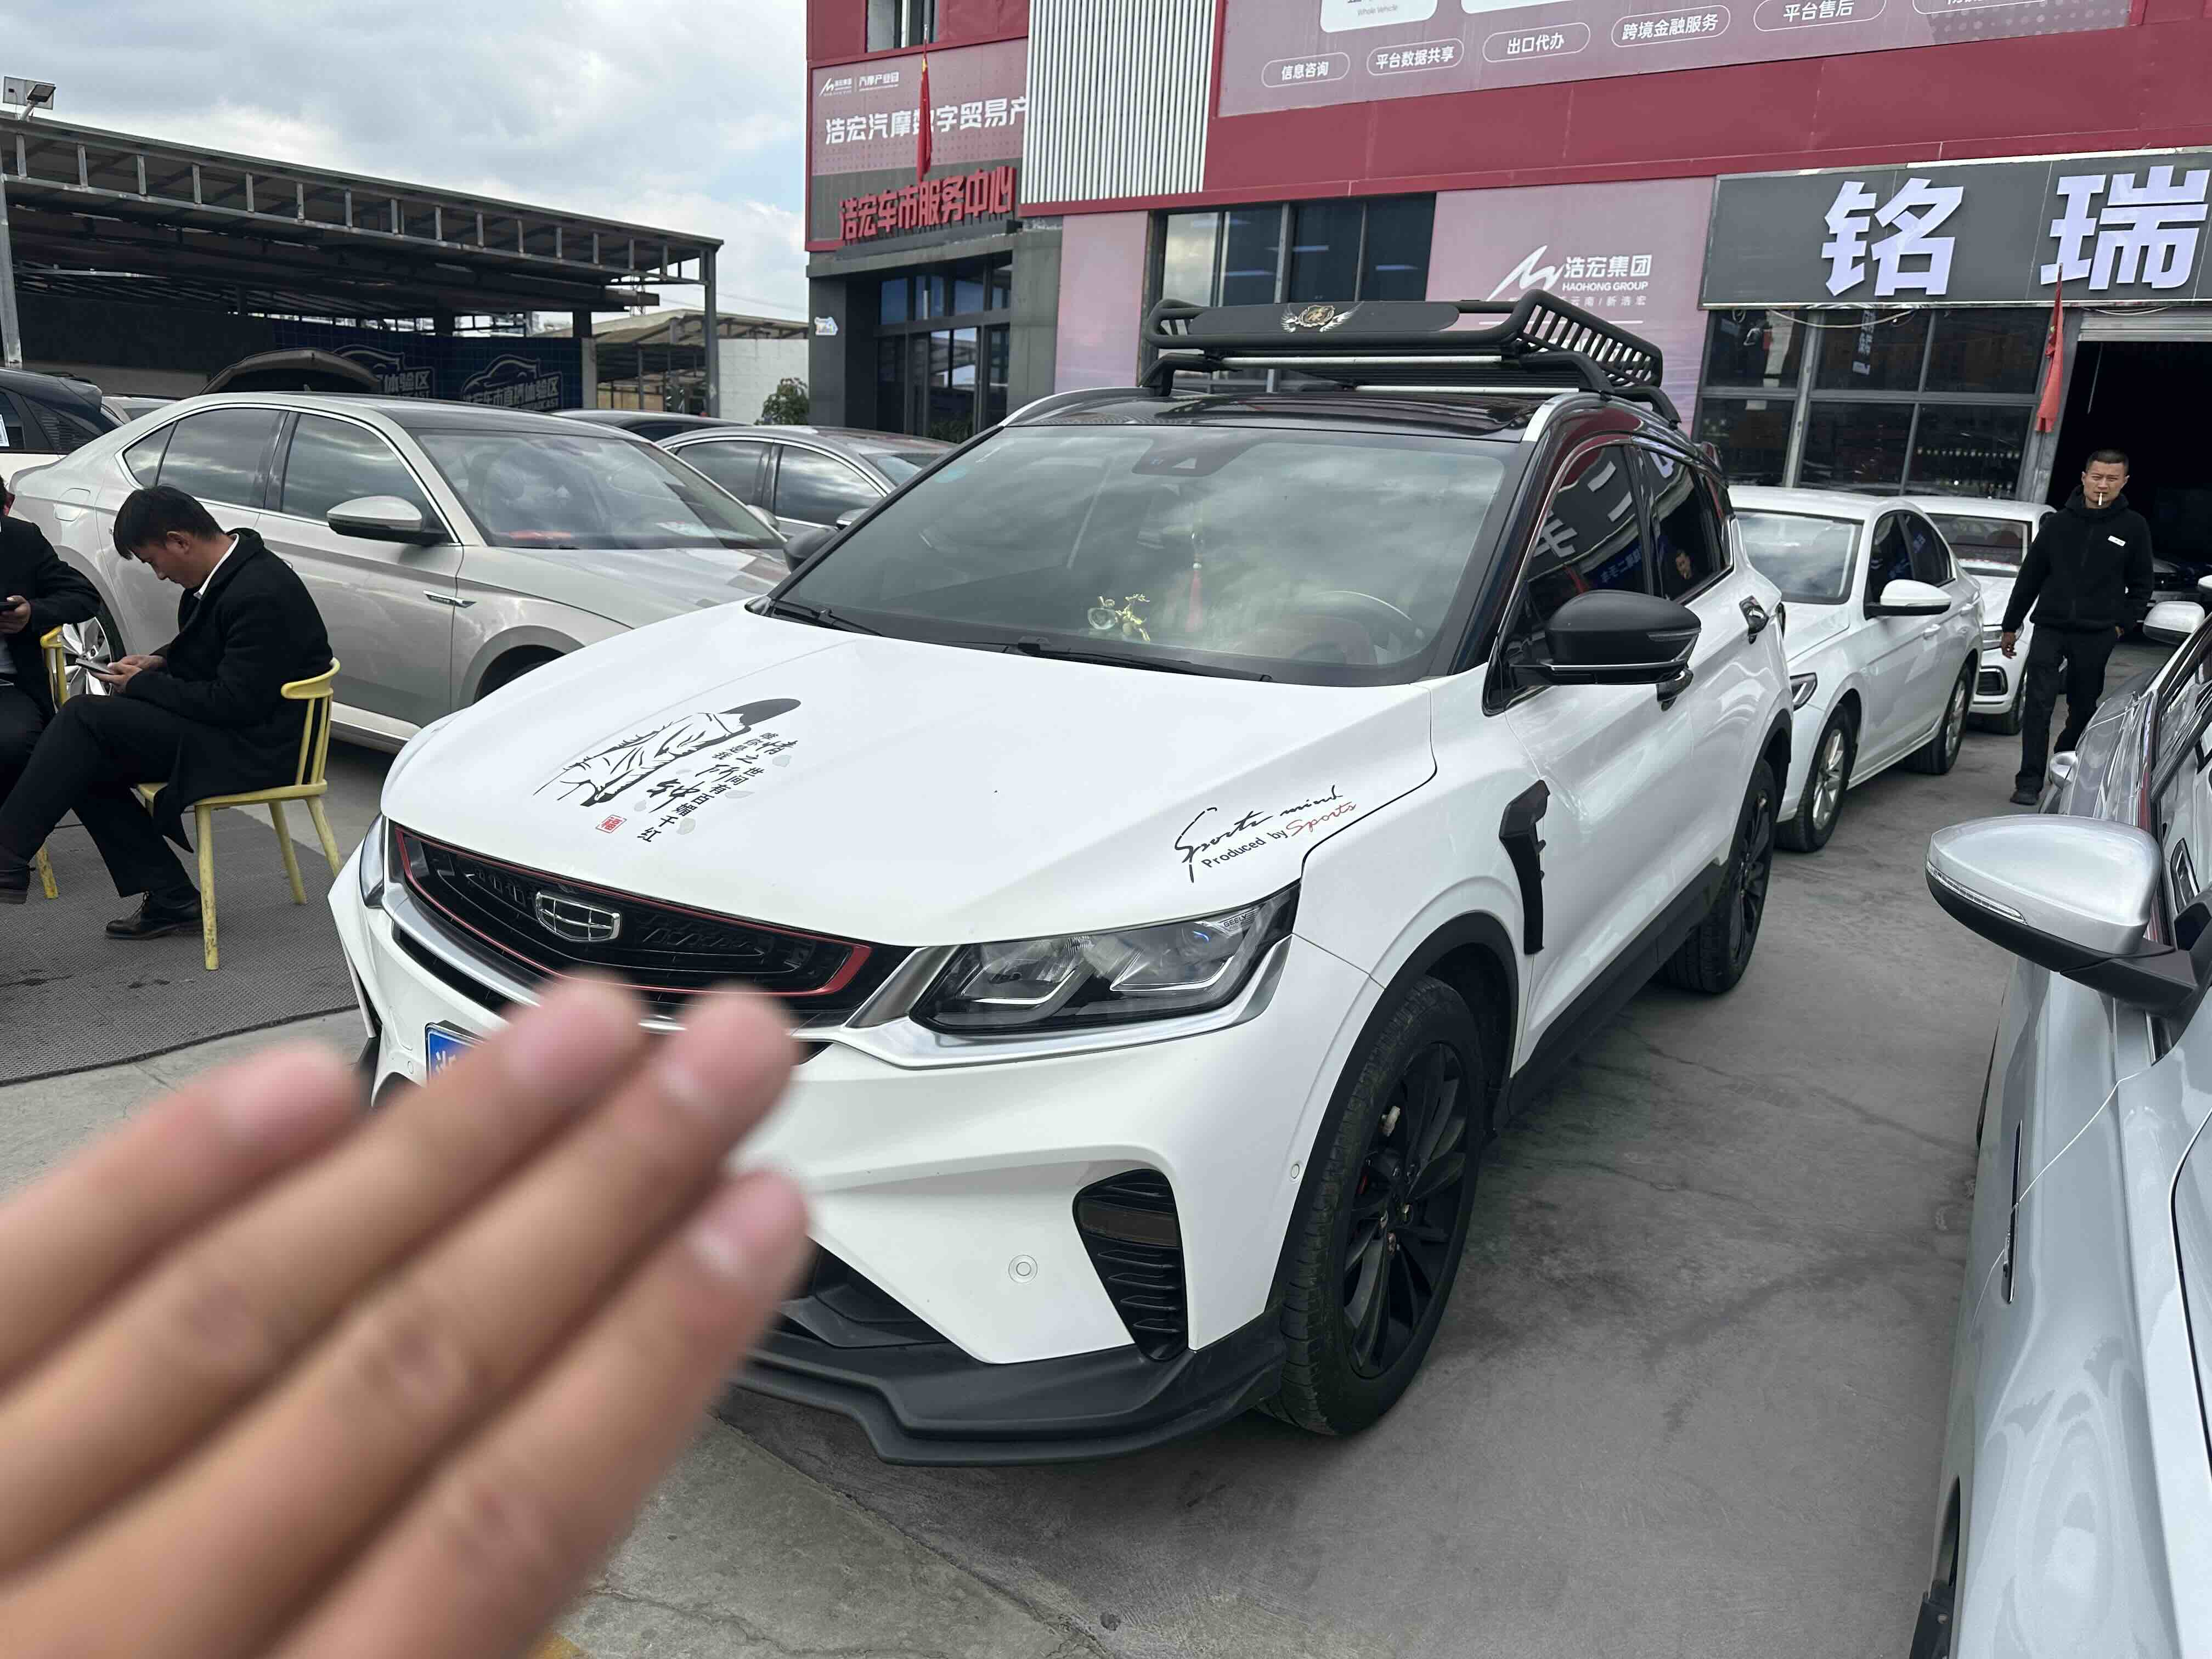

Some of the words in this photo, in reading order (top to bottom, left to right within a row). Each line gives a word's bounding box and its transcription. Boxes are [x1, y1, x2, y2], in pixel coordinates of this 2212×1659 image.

[1783, 0, 1854, 22] 平台售后
[1622, 14, 1718, 40] 跨境金融服务
[1507, 32, 1564, 54] 出口代办
[1376, 46, 1454, 69] 平台数据共享
[1282, 61, 1329, 81] 信息咨询
[839, 166, 1016, 240] 浩宏车市服务中心
[1822, 166, 2210, 296] 铭瑞
[1564, 255, 1652, 278] 浩宏集团
[1562, 281, 1611, 291] HAOHONG
[1613, 281, 1649, 291] GROUP
[637, 767, 764, 842] 世间有百媚千红
[1280, 784, 1344, 816] mind
[1201, 837, 1267, 868] Produced
[1267, 828, 1289, 840] by
[1285, 802, 1357, 837] Sports
[1223, 913, 1247, 927] GEELY
